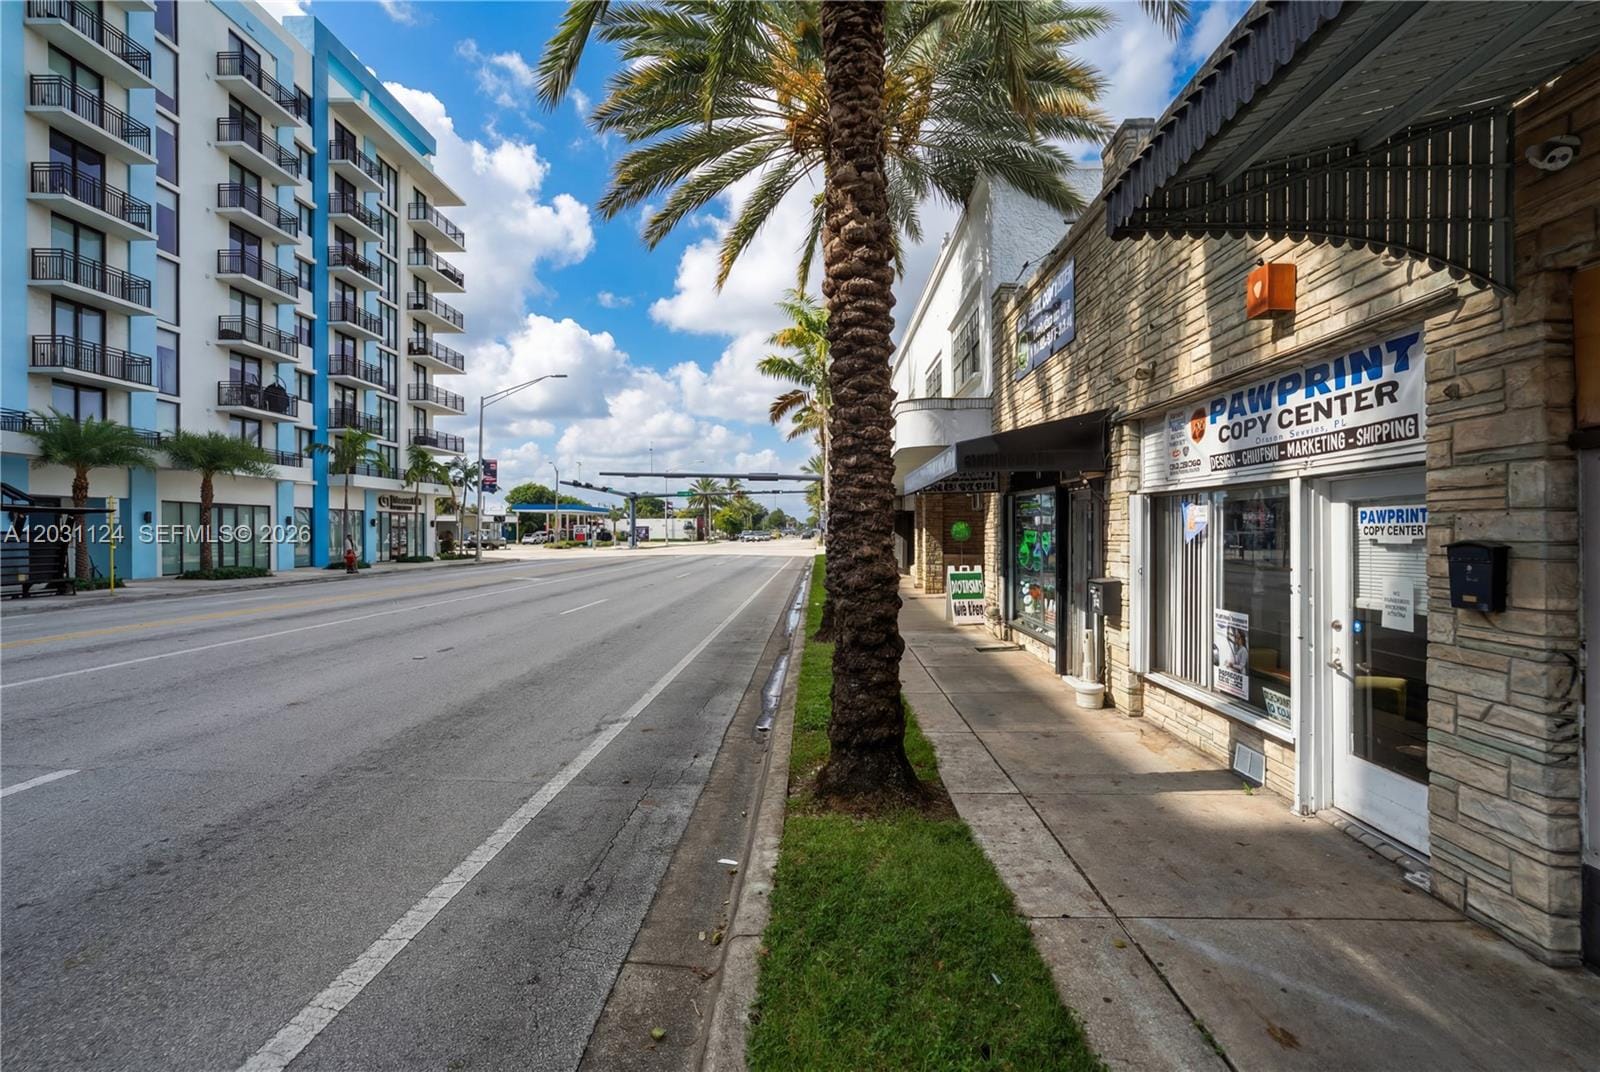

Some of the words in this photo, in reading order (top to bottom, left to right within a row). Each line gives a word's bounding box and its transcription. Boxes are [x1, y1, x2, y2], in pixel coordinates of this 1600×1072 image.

[1210, 332, 1420, 425] PAWPRINT
[1218, 413, 1273, 443] COPY
[1277, 380, 1400, 429] CENTER
[1210, 453, 1237, 470] DESIGN
[1287, 431, 1346, 457] MARKETING
[1355, 416, 1416, 446] SHIPPING
[1360, 508, 1428, 524] PAWPRINT
[1363, 525, 1386, 536] COPY
[1387, 525, 1424, 536] CENTER
